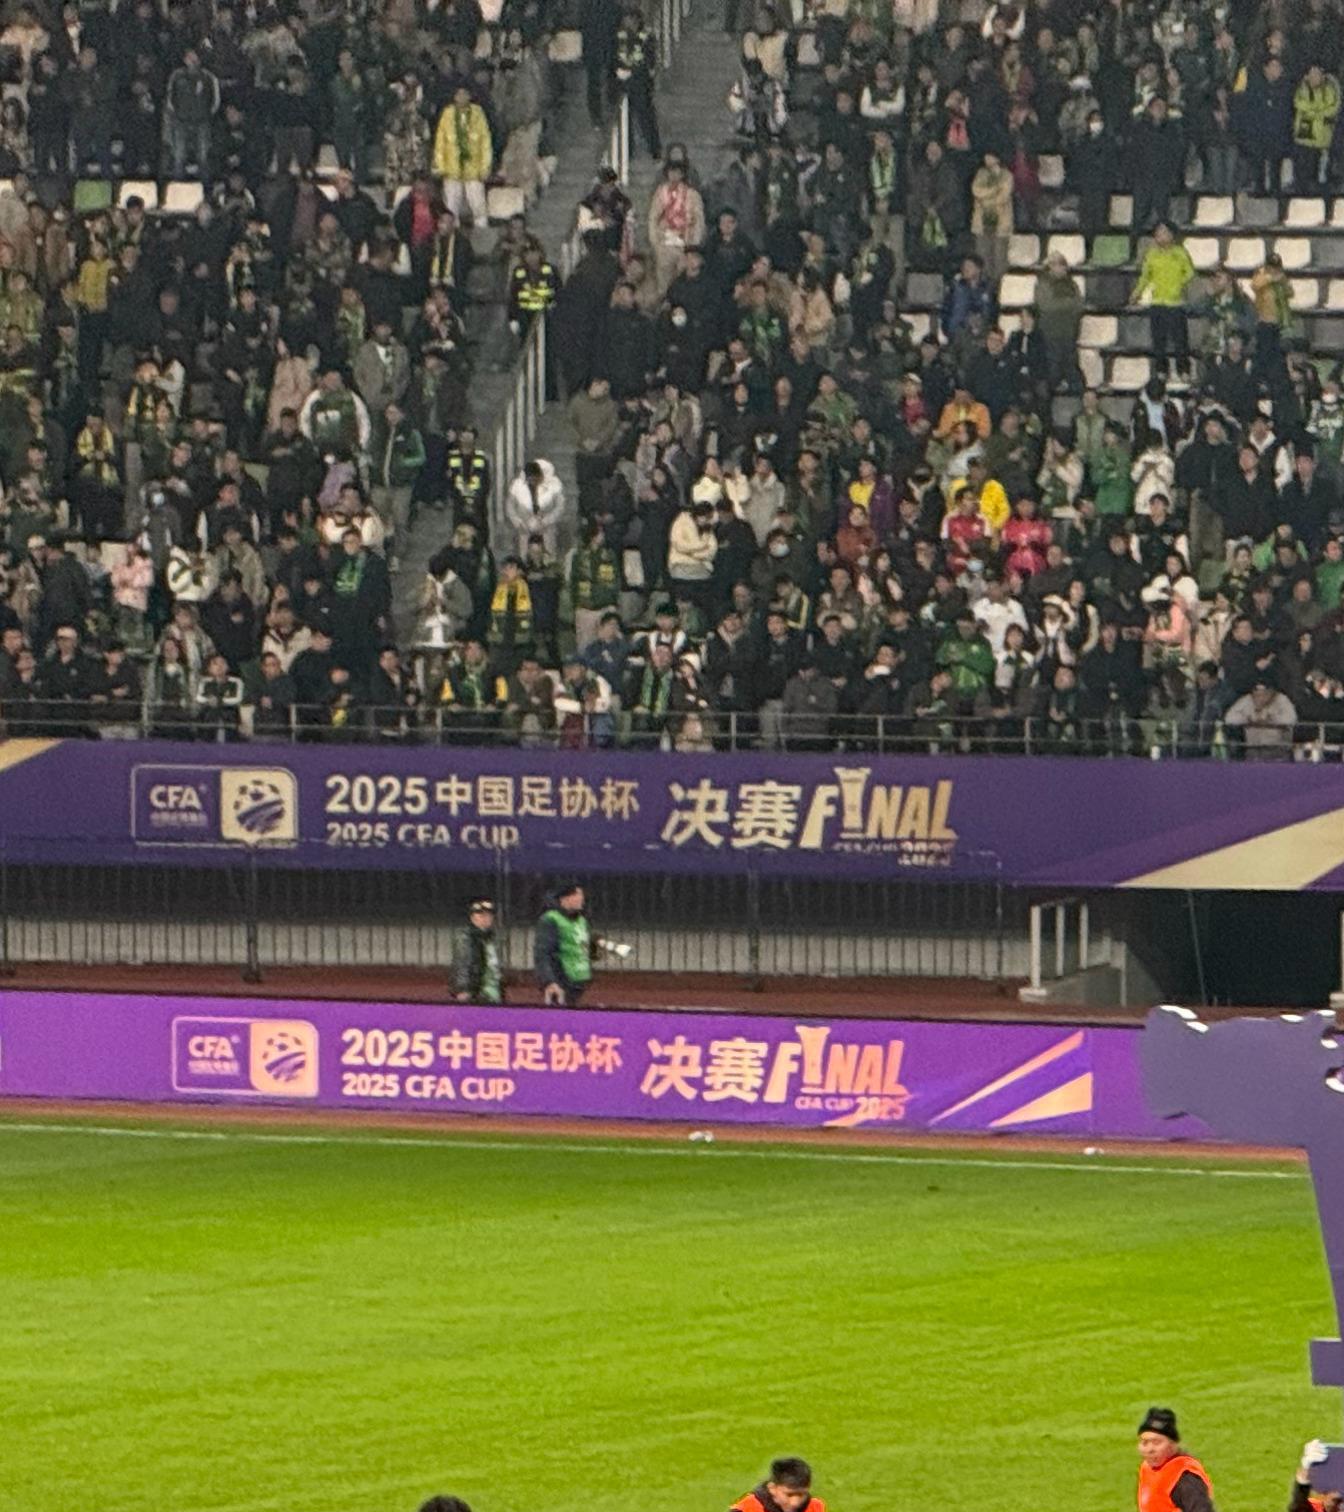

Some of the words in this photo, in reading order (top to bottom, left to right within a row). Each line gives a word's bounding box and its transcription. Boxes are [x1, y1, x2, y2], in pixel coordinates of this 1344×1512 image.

[149, 784, 202, 811] CFA
[325, 773, 641, 820] 2025中国足协杯
[661, 778, 802, 848] 决赛
[460, 824, 521, 850] CUP
[188, 1035, 236, 1061] CFA
[341, 1028, 624, 1074] 2025中国足协杯
[341, 1072, 400, 1099] 2025
[404, 1075, 457, 1100] CFA
[460, 1076, 517, 1102] CUP
[640, 1035, 769, 1103] 决赛
